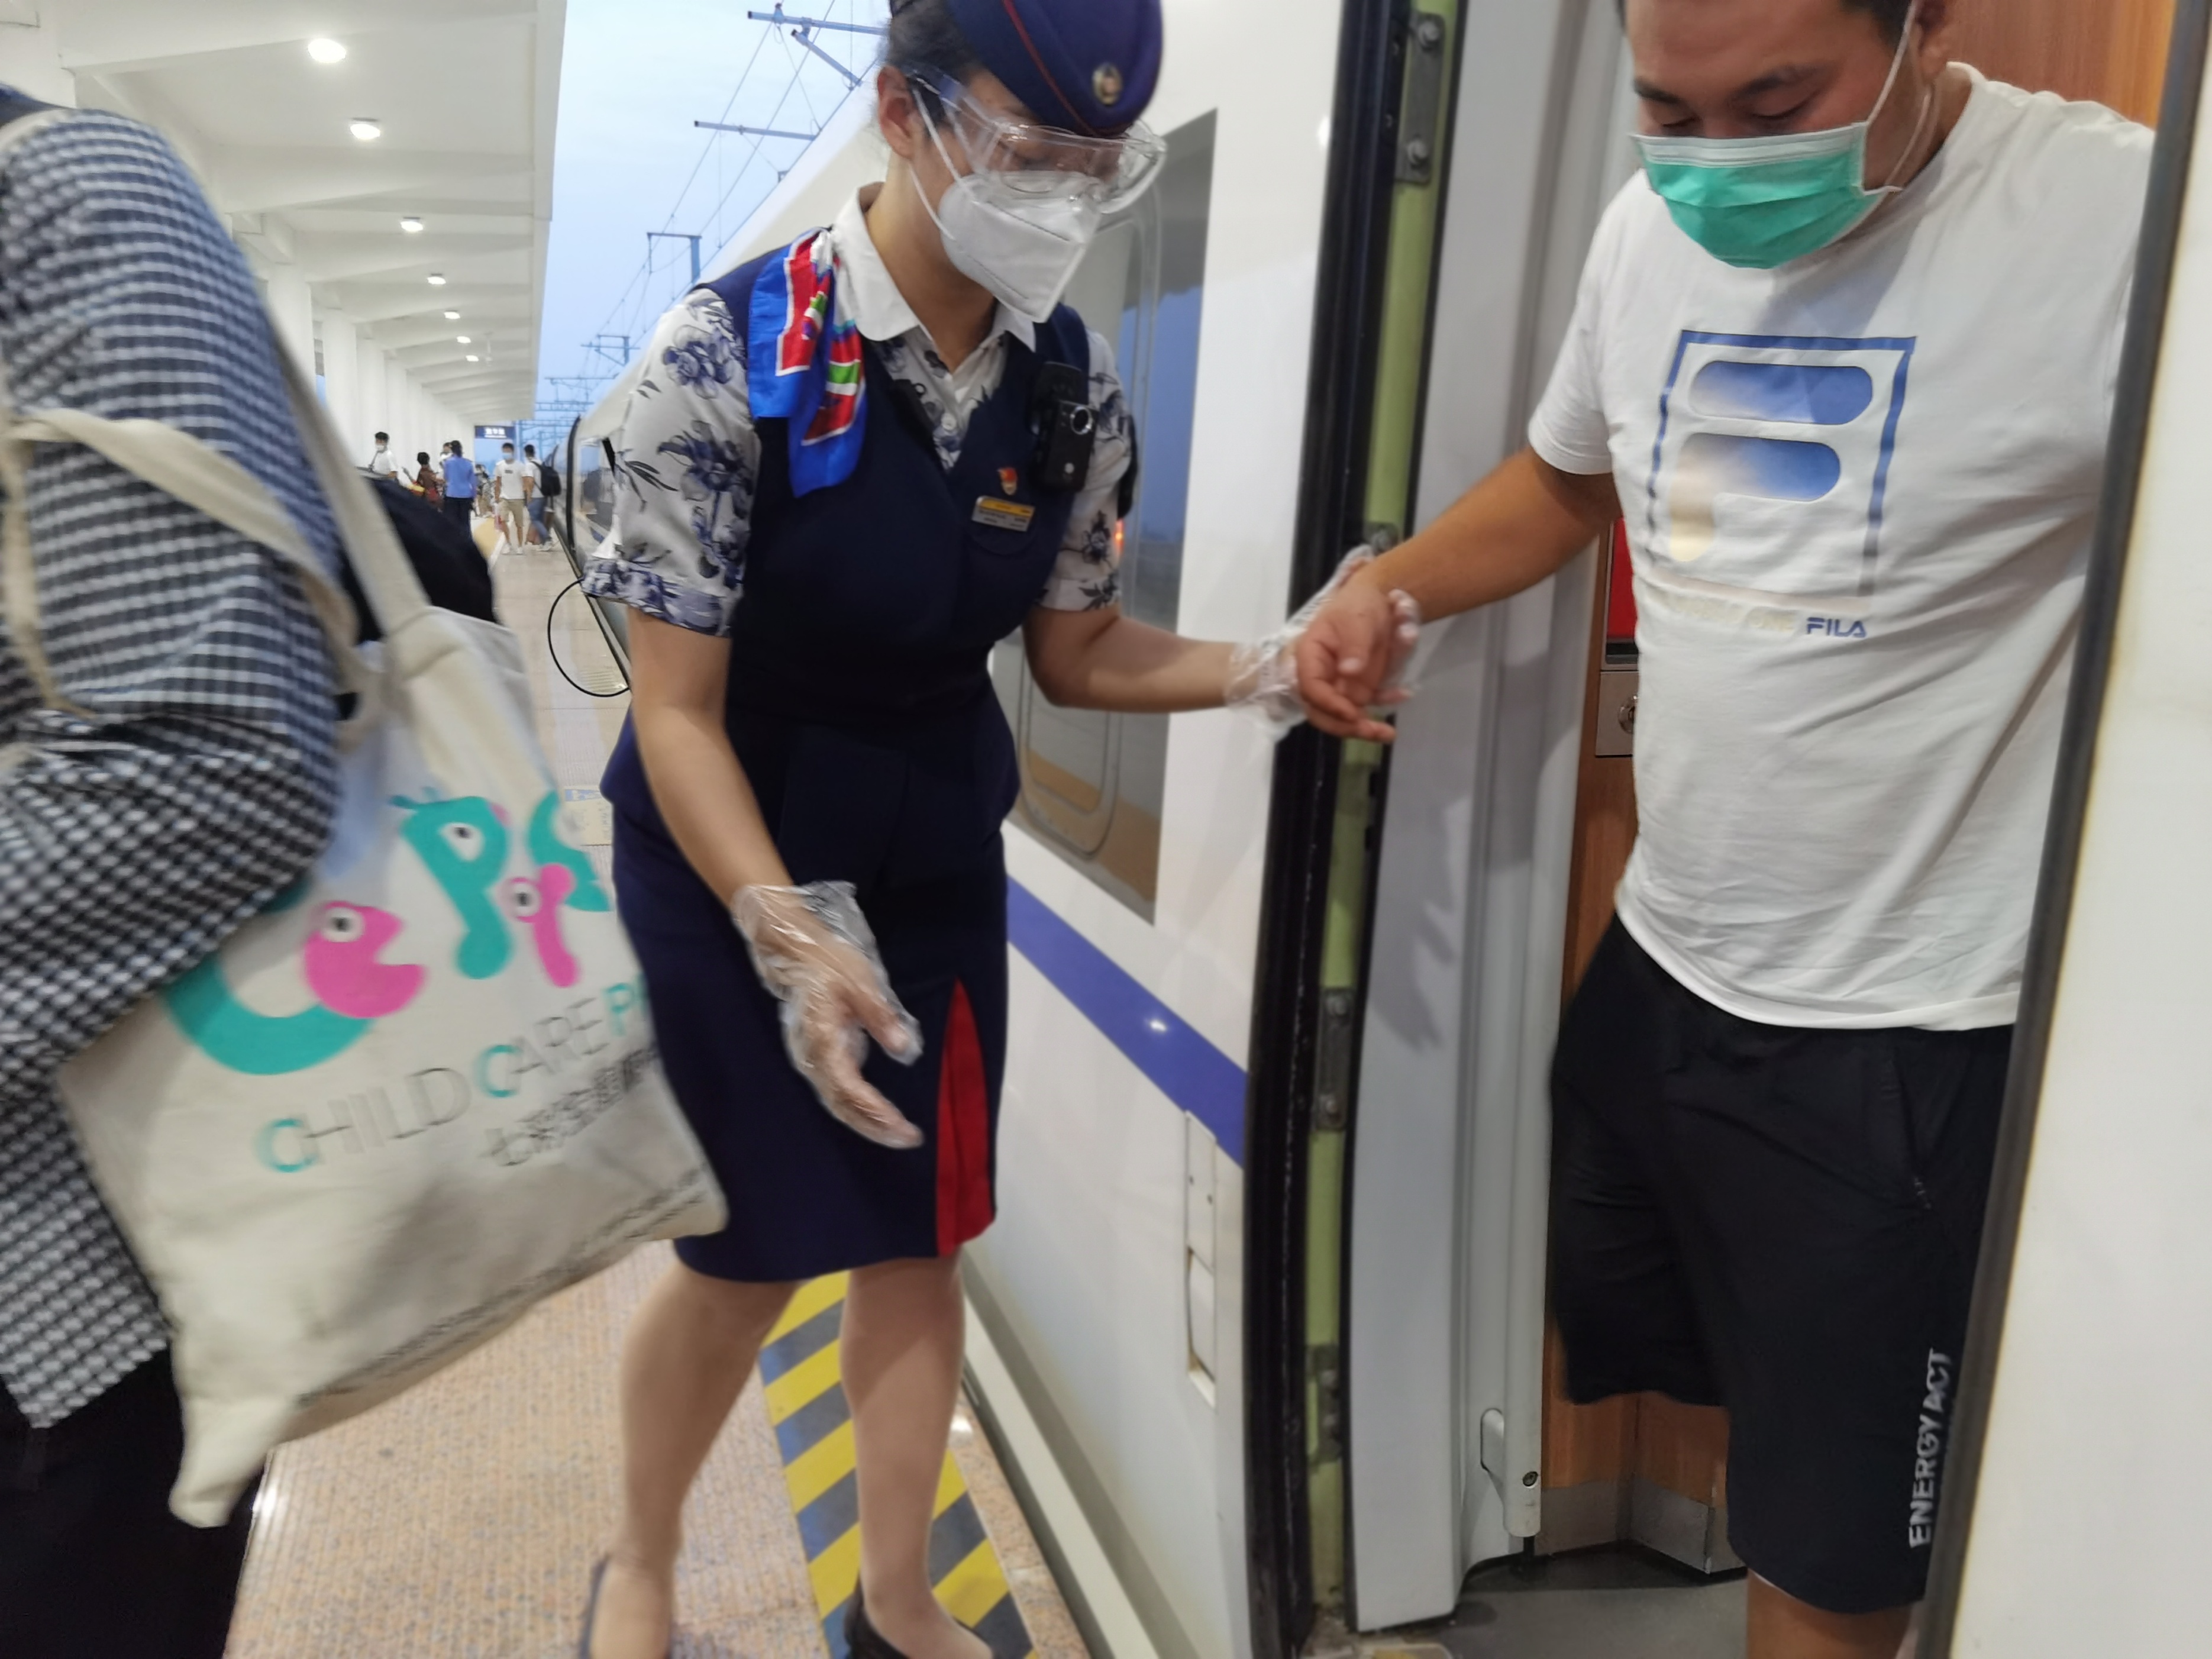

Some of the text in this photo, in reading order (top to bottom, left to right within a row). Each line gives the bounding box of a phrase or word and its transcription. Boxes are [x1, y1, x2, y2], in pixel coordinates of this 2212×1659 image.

[1806, 617, 1868, 639] FILA
[253, 1067, 472, 1174] CHILD
[1908, 1347, 1952, 1548] ENERGY ACT
